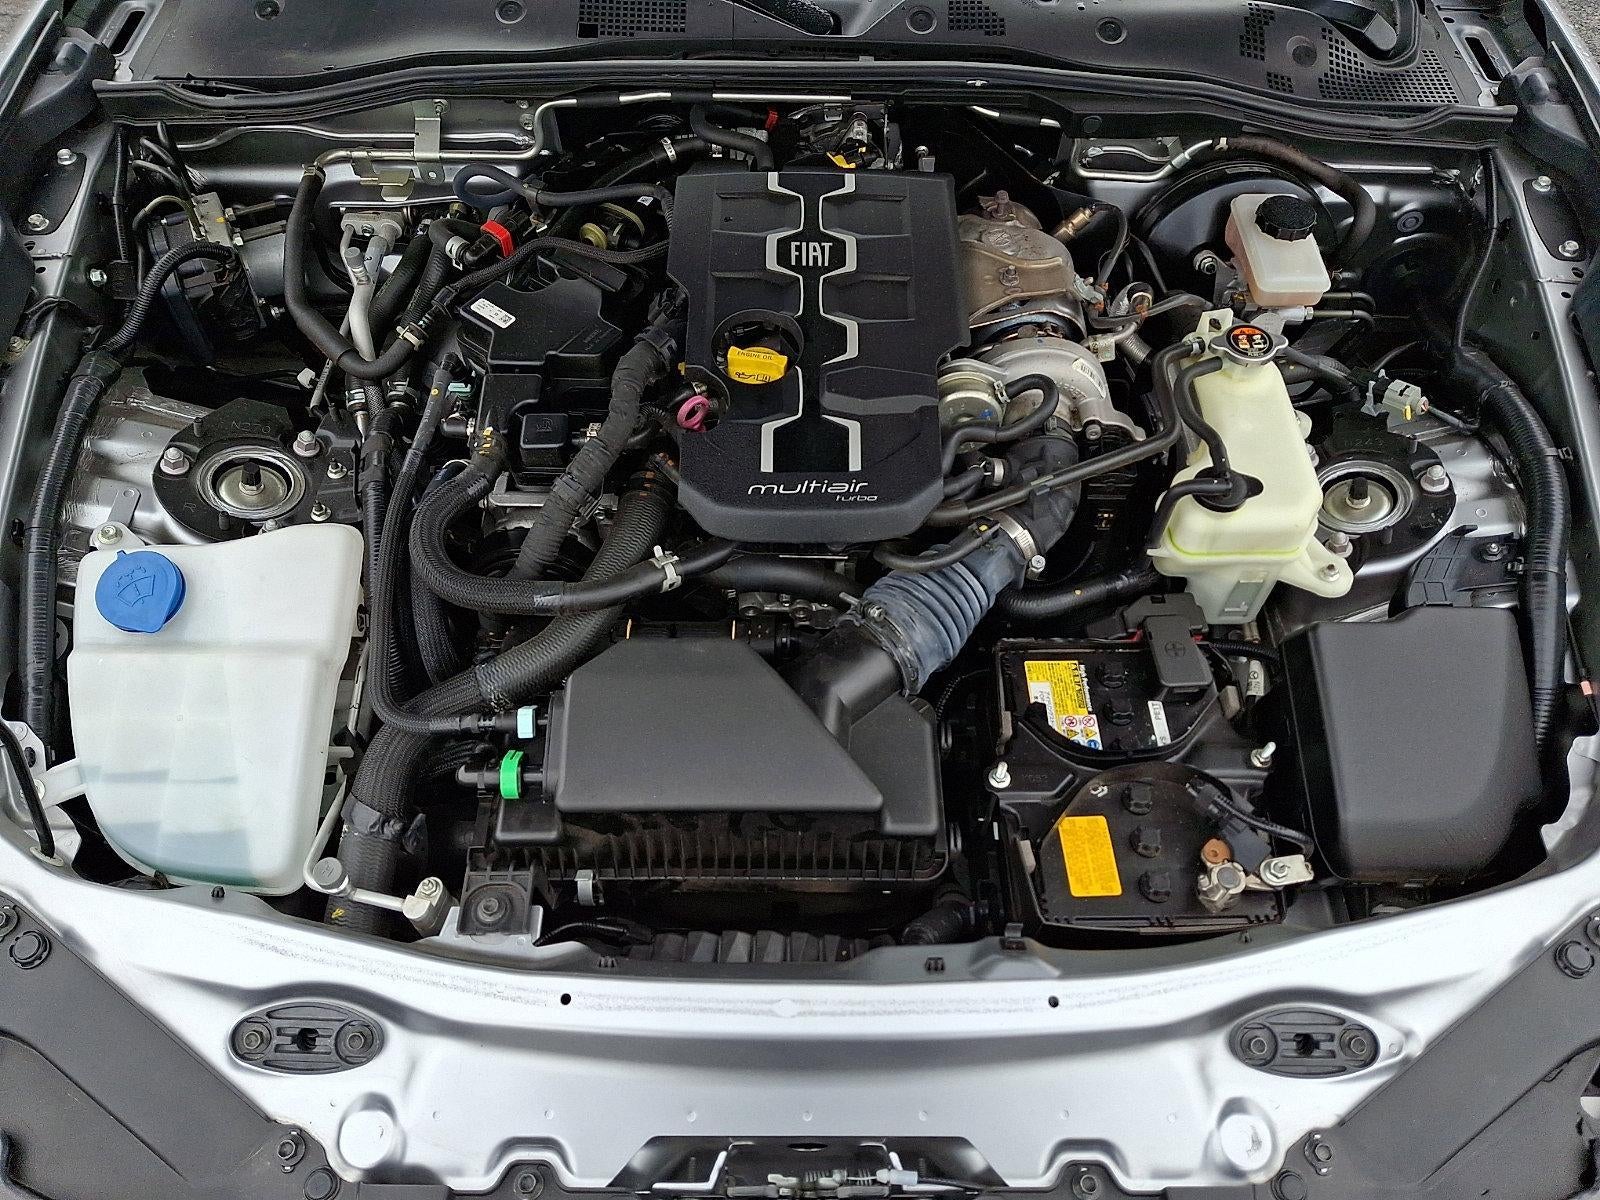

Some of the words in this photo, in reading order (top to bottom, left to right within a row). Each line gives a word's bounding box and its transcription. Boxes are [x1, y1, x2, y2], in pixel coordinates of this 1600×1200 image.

[790, 241, 833, 267] FIAT
[737, 350, 760, 359] ENGINE
[747, 479, 868, 495] multiair
[836, 494, 878, 502] turbo
